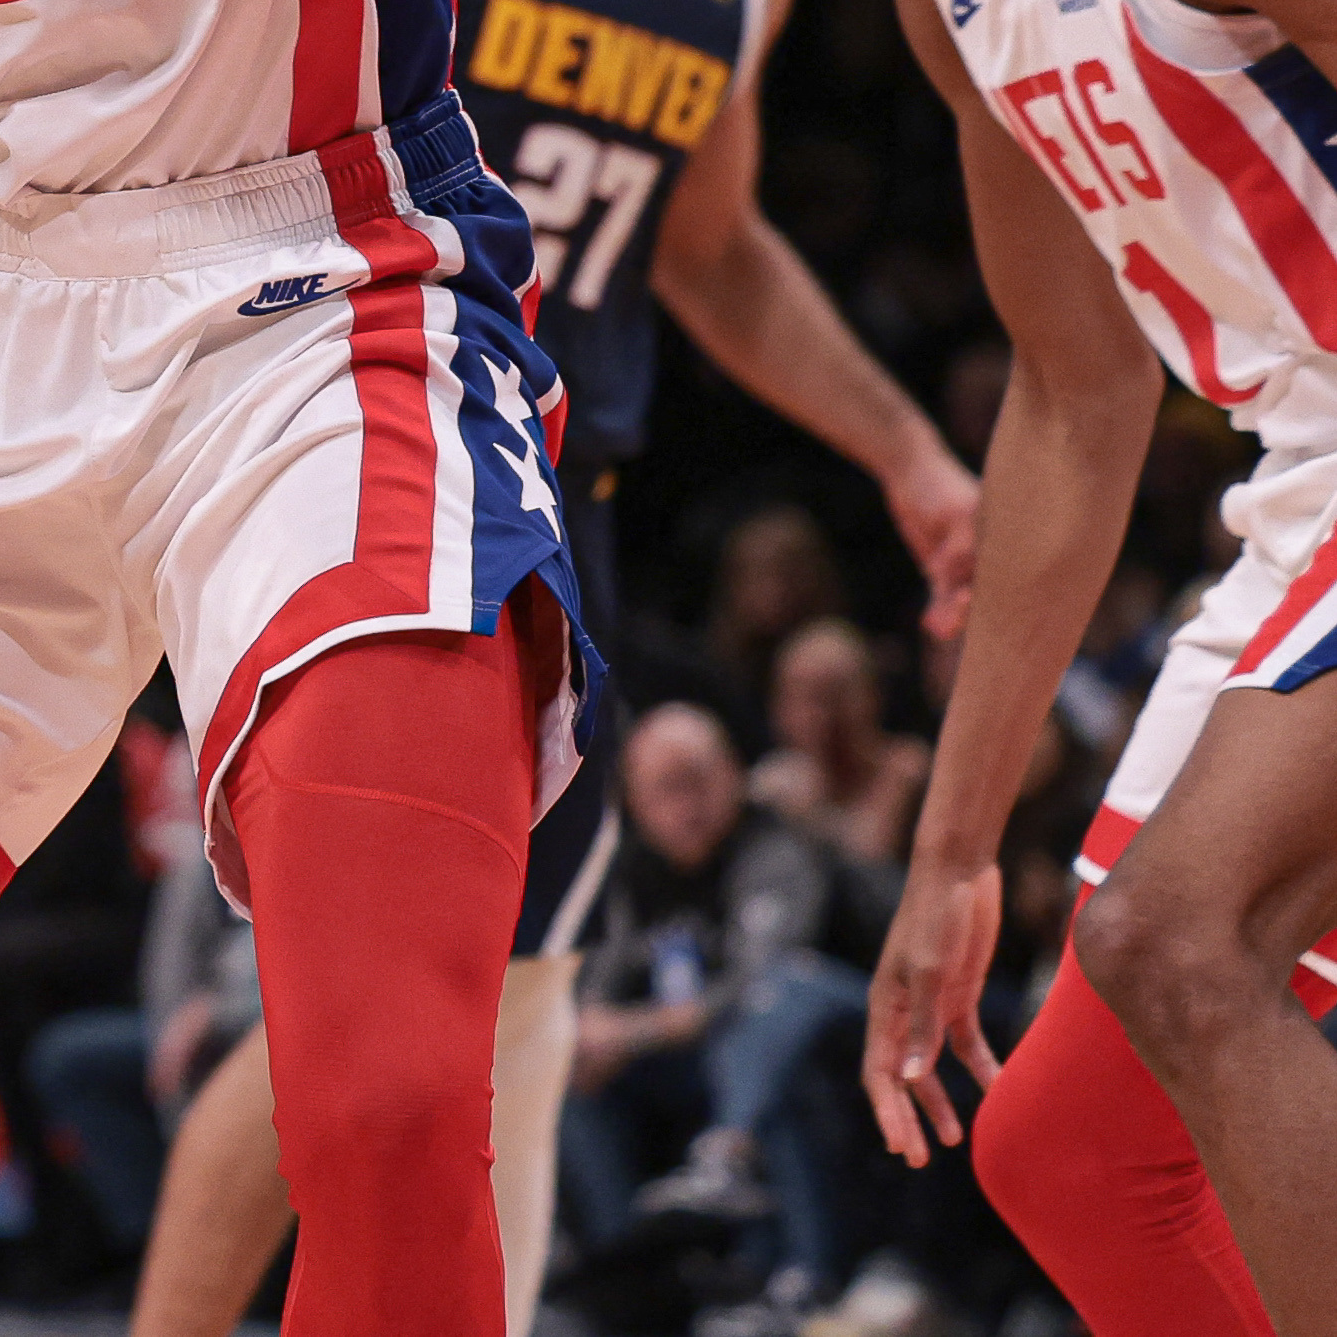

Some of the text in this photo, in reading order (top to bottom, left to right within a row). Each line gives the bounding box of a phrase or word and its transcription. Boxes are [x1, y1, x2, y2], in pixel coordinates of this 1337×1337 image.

[994, 57, 1167, 213] ETS
[255, 272, 329, 306] NIKE
[513, 123, 664, 310] 27
